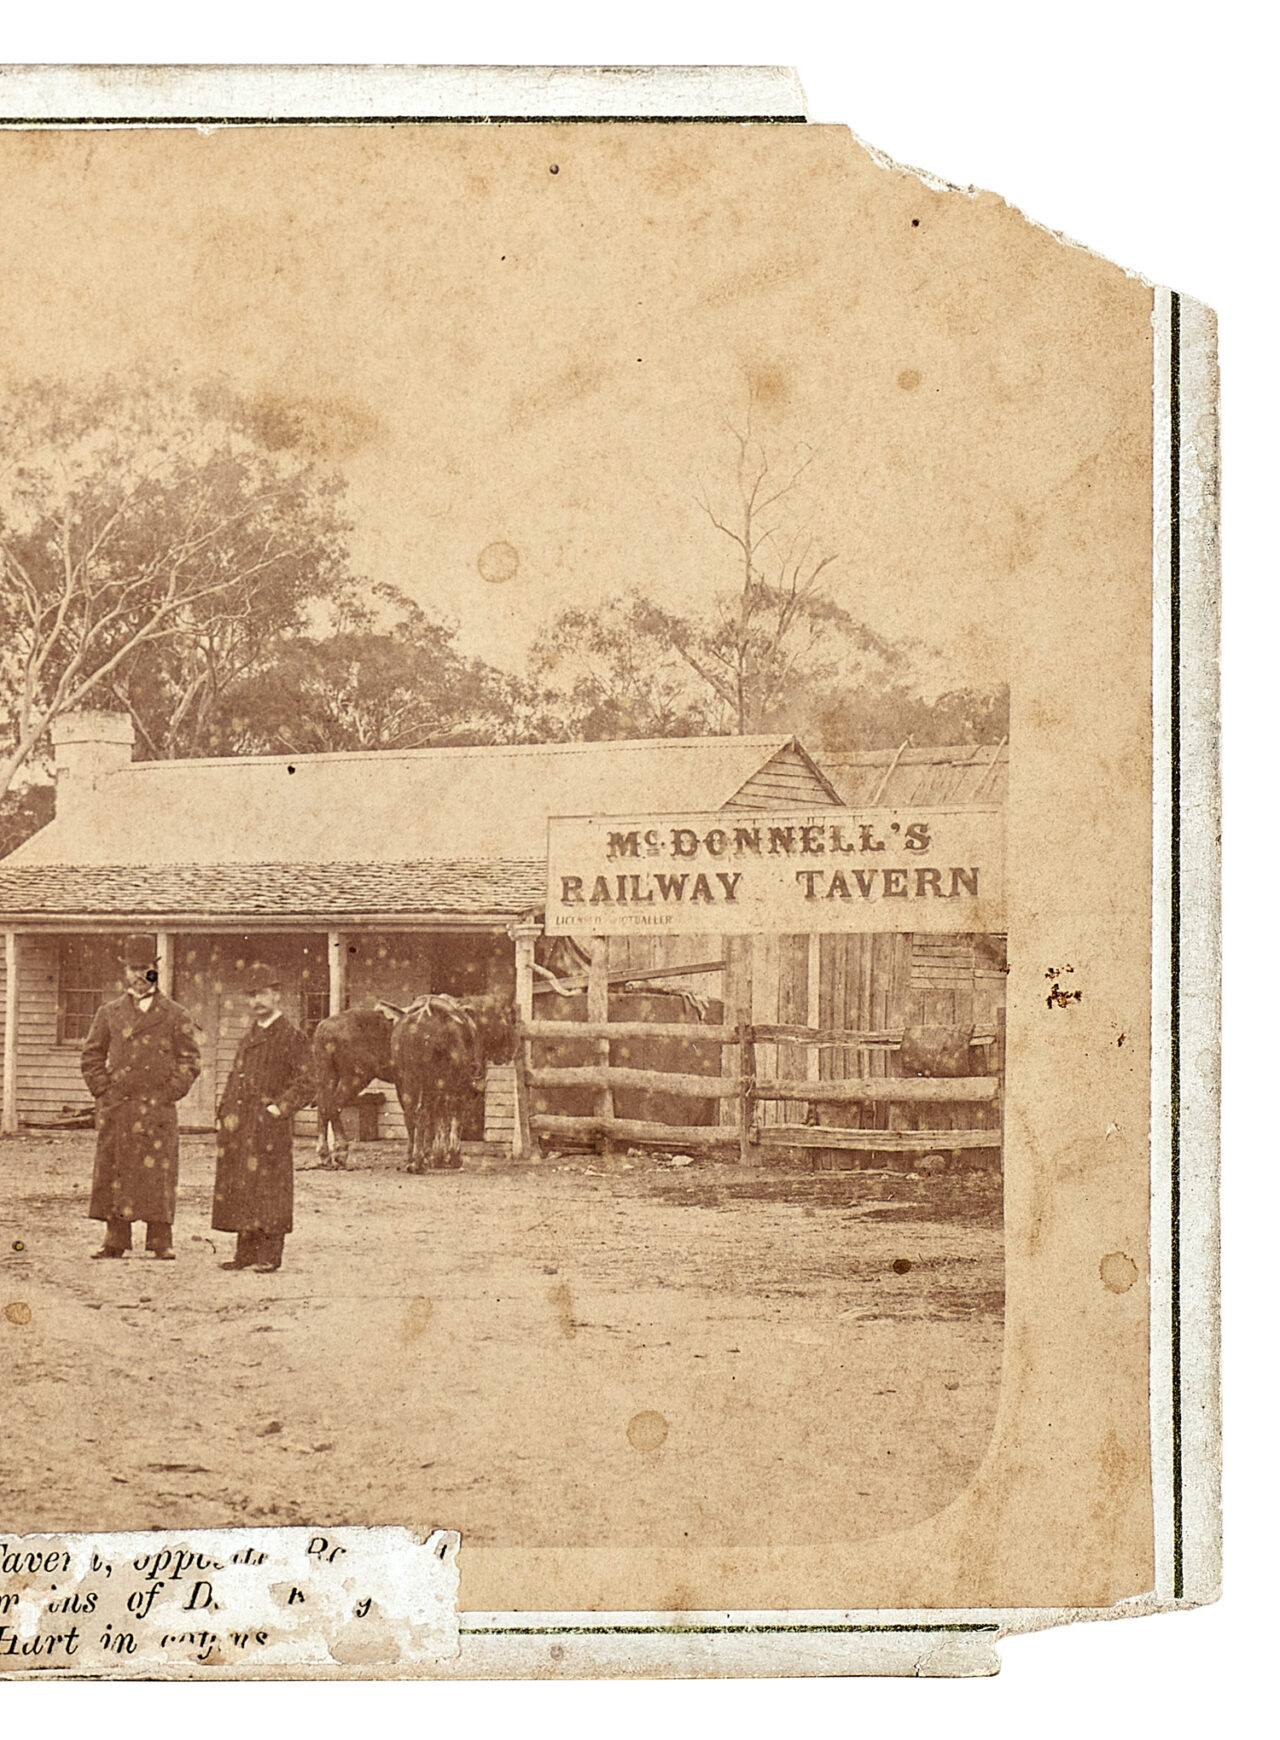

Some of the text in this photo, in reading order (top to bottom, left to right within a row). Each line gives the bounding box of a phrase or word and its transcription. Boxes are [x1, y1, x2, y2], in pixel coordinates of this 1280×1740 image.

[560, 866, 981, 905] RAILWAY TAVERN
[126, 1581, 166, 1619] of
[99, 1623, 138, 1654] in
